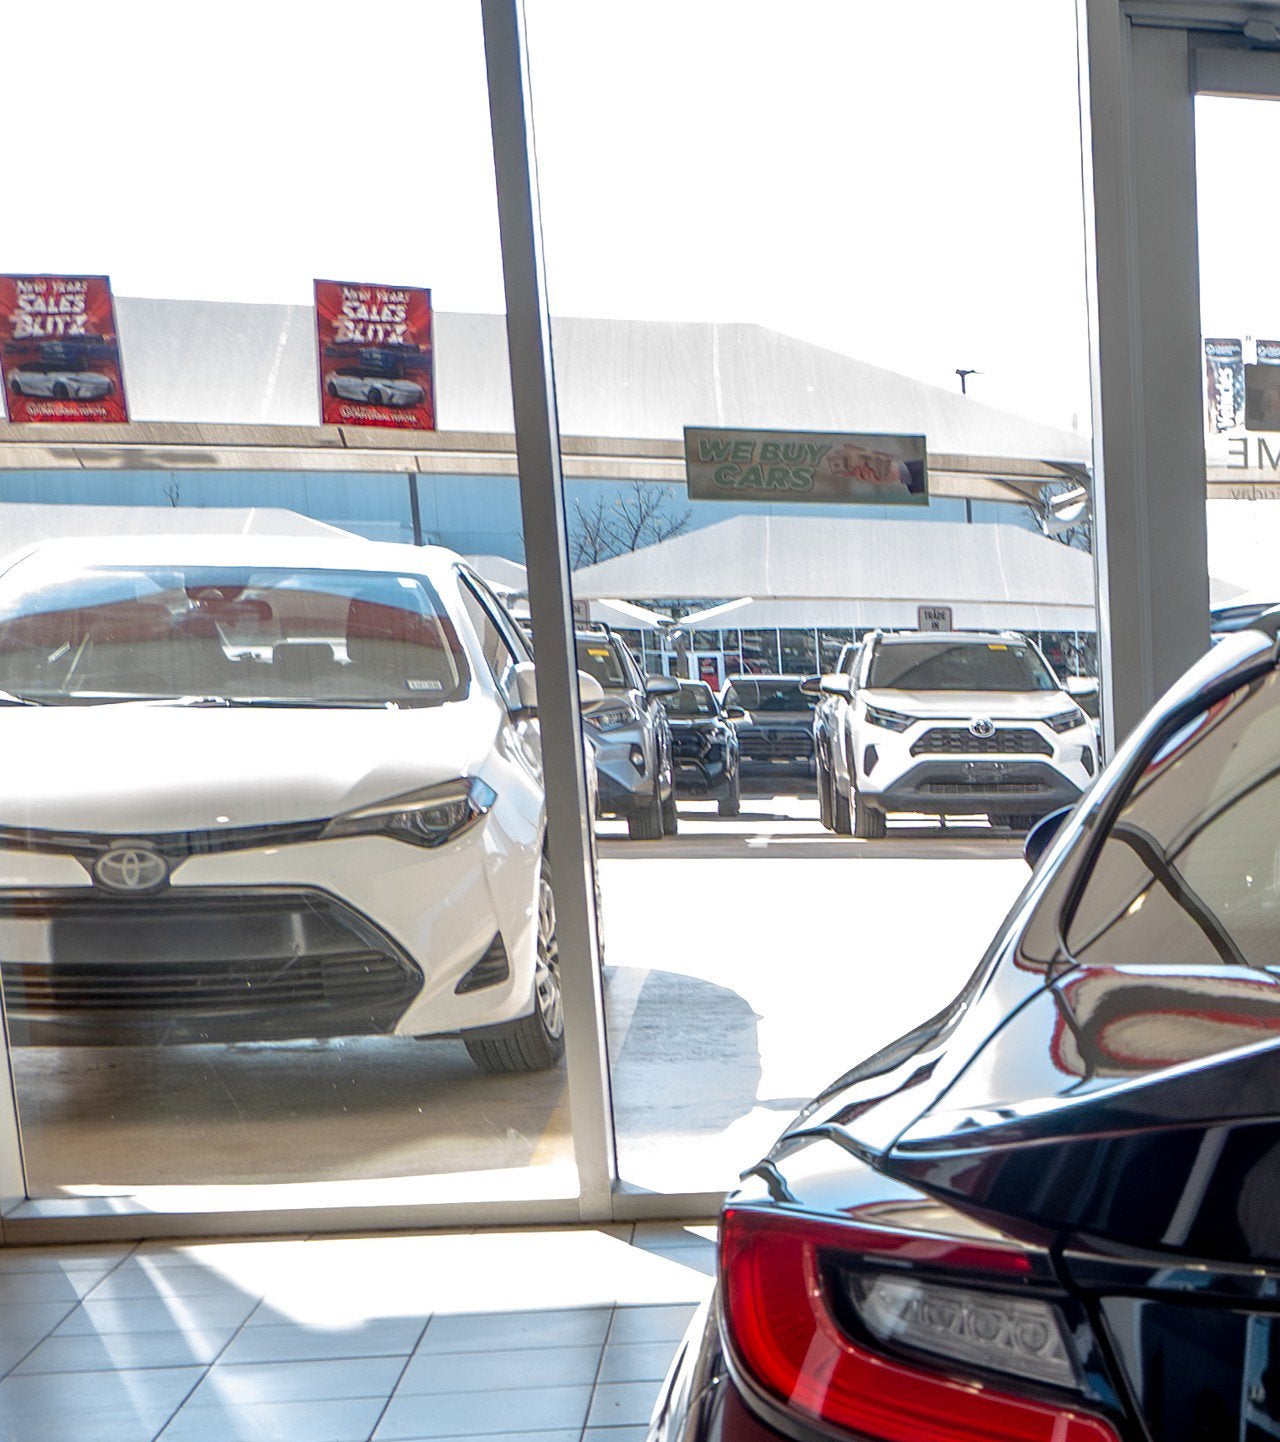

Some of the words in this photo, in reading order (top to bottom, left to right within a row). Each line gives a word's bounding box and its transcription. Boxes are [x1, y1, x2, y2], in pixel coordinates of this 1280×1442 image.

[18, 294, 85, 314] SALES
[342, 302, 408, 323] SALES
[13, 313, 88, 338] BLITZ
[335, 320, 408, 344] BLITZ
[698, 439, 755, 463] WE
[759, 440, 832, 465] BUY
[713, 463, 816, 492] CARS
